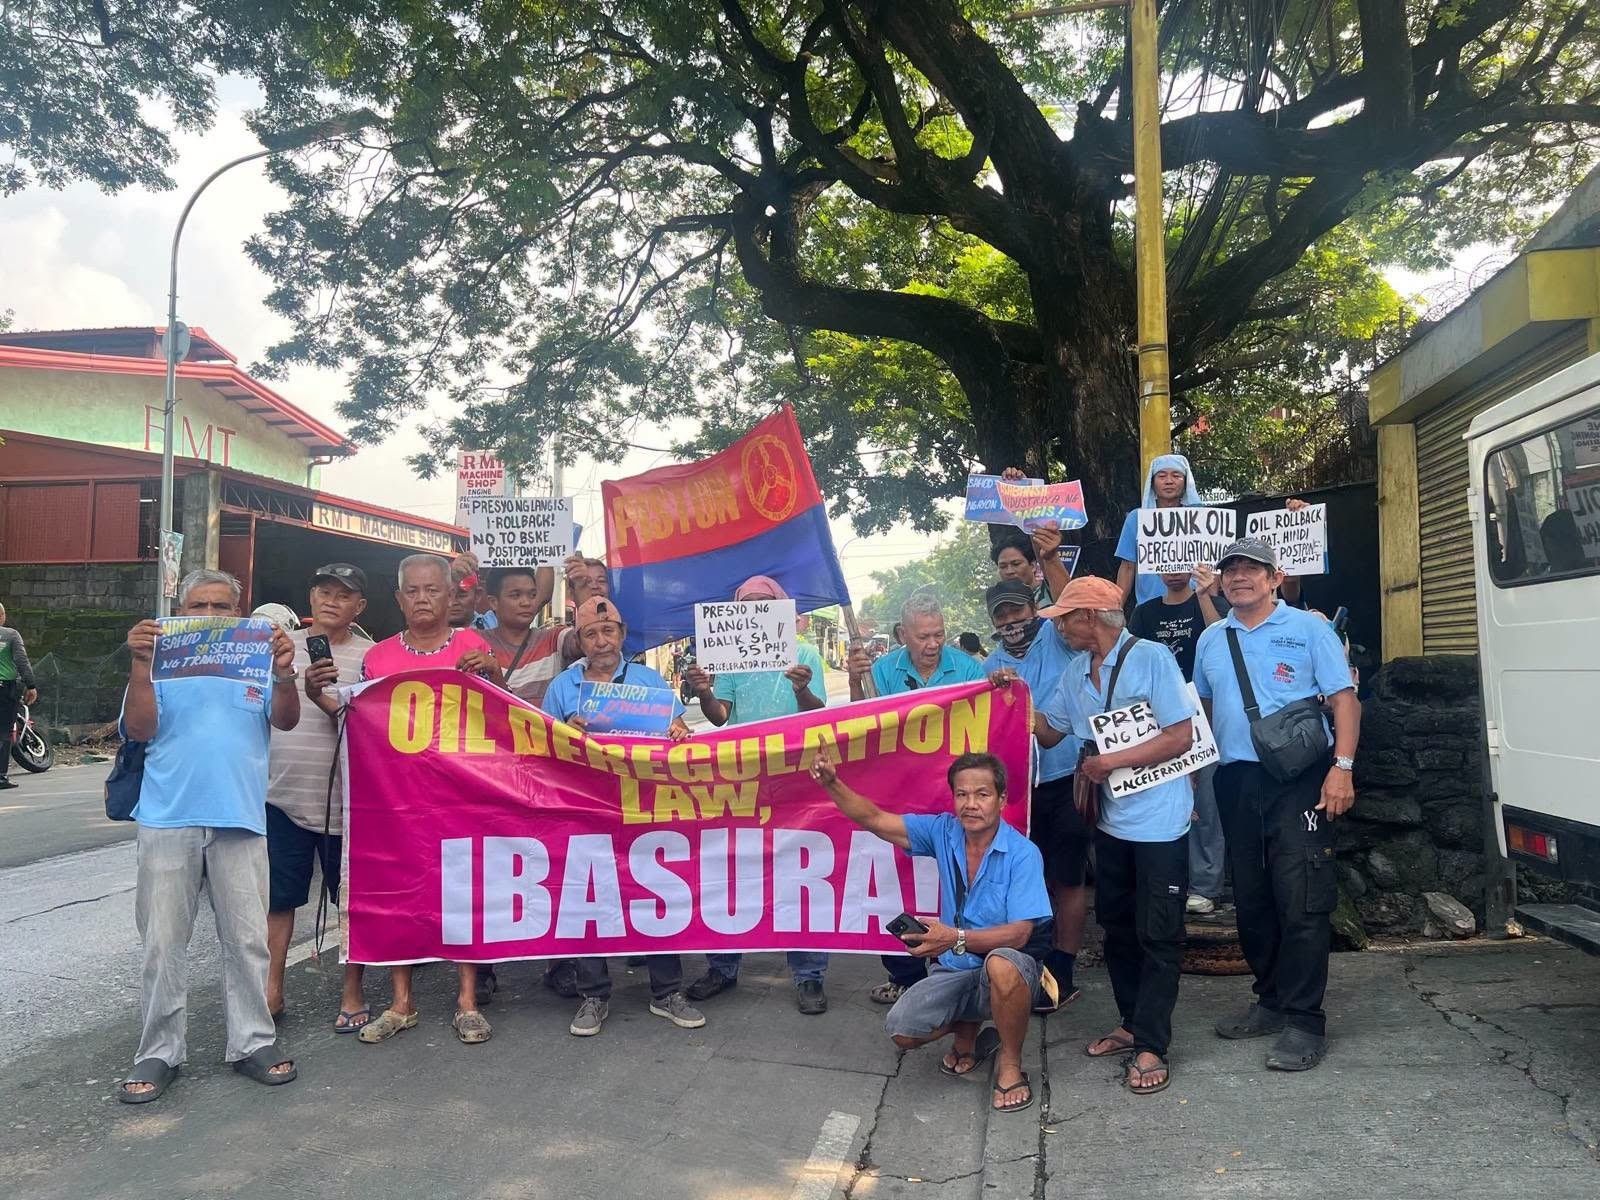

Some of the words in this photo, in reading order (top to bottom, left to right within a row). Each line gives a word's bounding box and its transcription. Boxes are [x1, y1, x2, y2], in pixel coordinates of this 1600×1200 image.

[460, 470, 503, 480] MACHINE
[467, 480, 497, 488] SHOP
[472, 500, 513, 514] PRESYO
[515, 500, 530, 512] NG
[319, 505, 353, 530] RMT
[359, 515, 416, 544] MACHINE
[419, 529, 450, 550] SHOP
[1142, 510, 1201, 537] JUNK
[1205, 510, 1235, 537] OIL
[1249, 516, 1270, 534] OIL
[1275, 508, 1322, 529] ROLLBACK
[473, 532, 496, 545] NO
[499, 532, 516, 544] TO
[520, 531, 550, 544] BSKE
[1283, 527, 1309, 544] HINDI
[1138, 540, 1218, 564] DEREGULATION
[1292, 553, 1321, 565] MENT
[702, 603, 748, 619] PRESYO
[754, 603, 770, 614] NG
[161, 631, 202, 652] SAHOD
[209, 641, 269, 655] SERBISYO
[703, 634, 745, 649] IBALIK
[750, 631, 769, 644] SA
[738, 644, 762, 658] 55
[764, 641, 788, 654] PHP
[161, 659, 181, 671] NG
[181, 653, 252, 668] TRANSPORT
[389, 682, 496, 755] OIL
[510, 692, 990, 781] DEREGULATION
[1104, 731, 1131, 749] NG
[1190, 744, 1217, 765] PISTON
[620, 772, 772, 825] LAW,
[441, 828, 941, 946] IBASURA!
